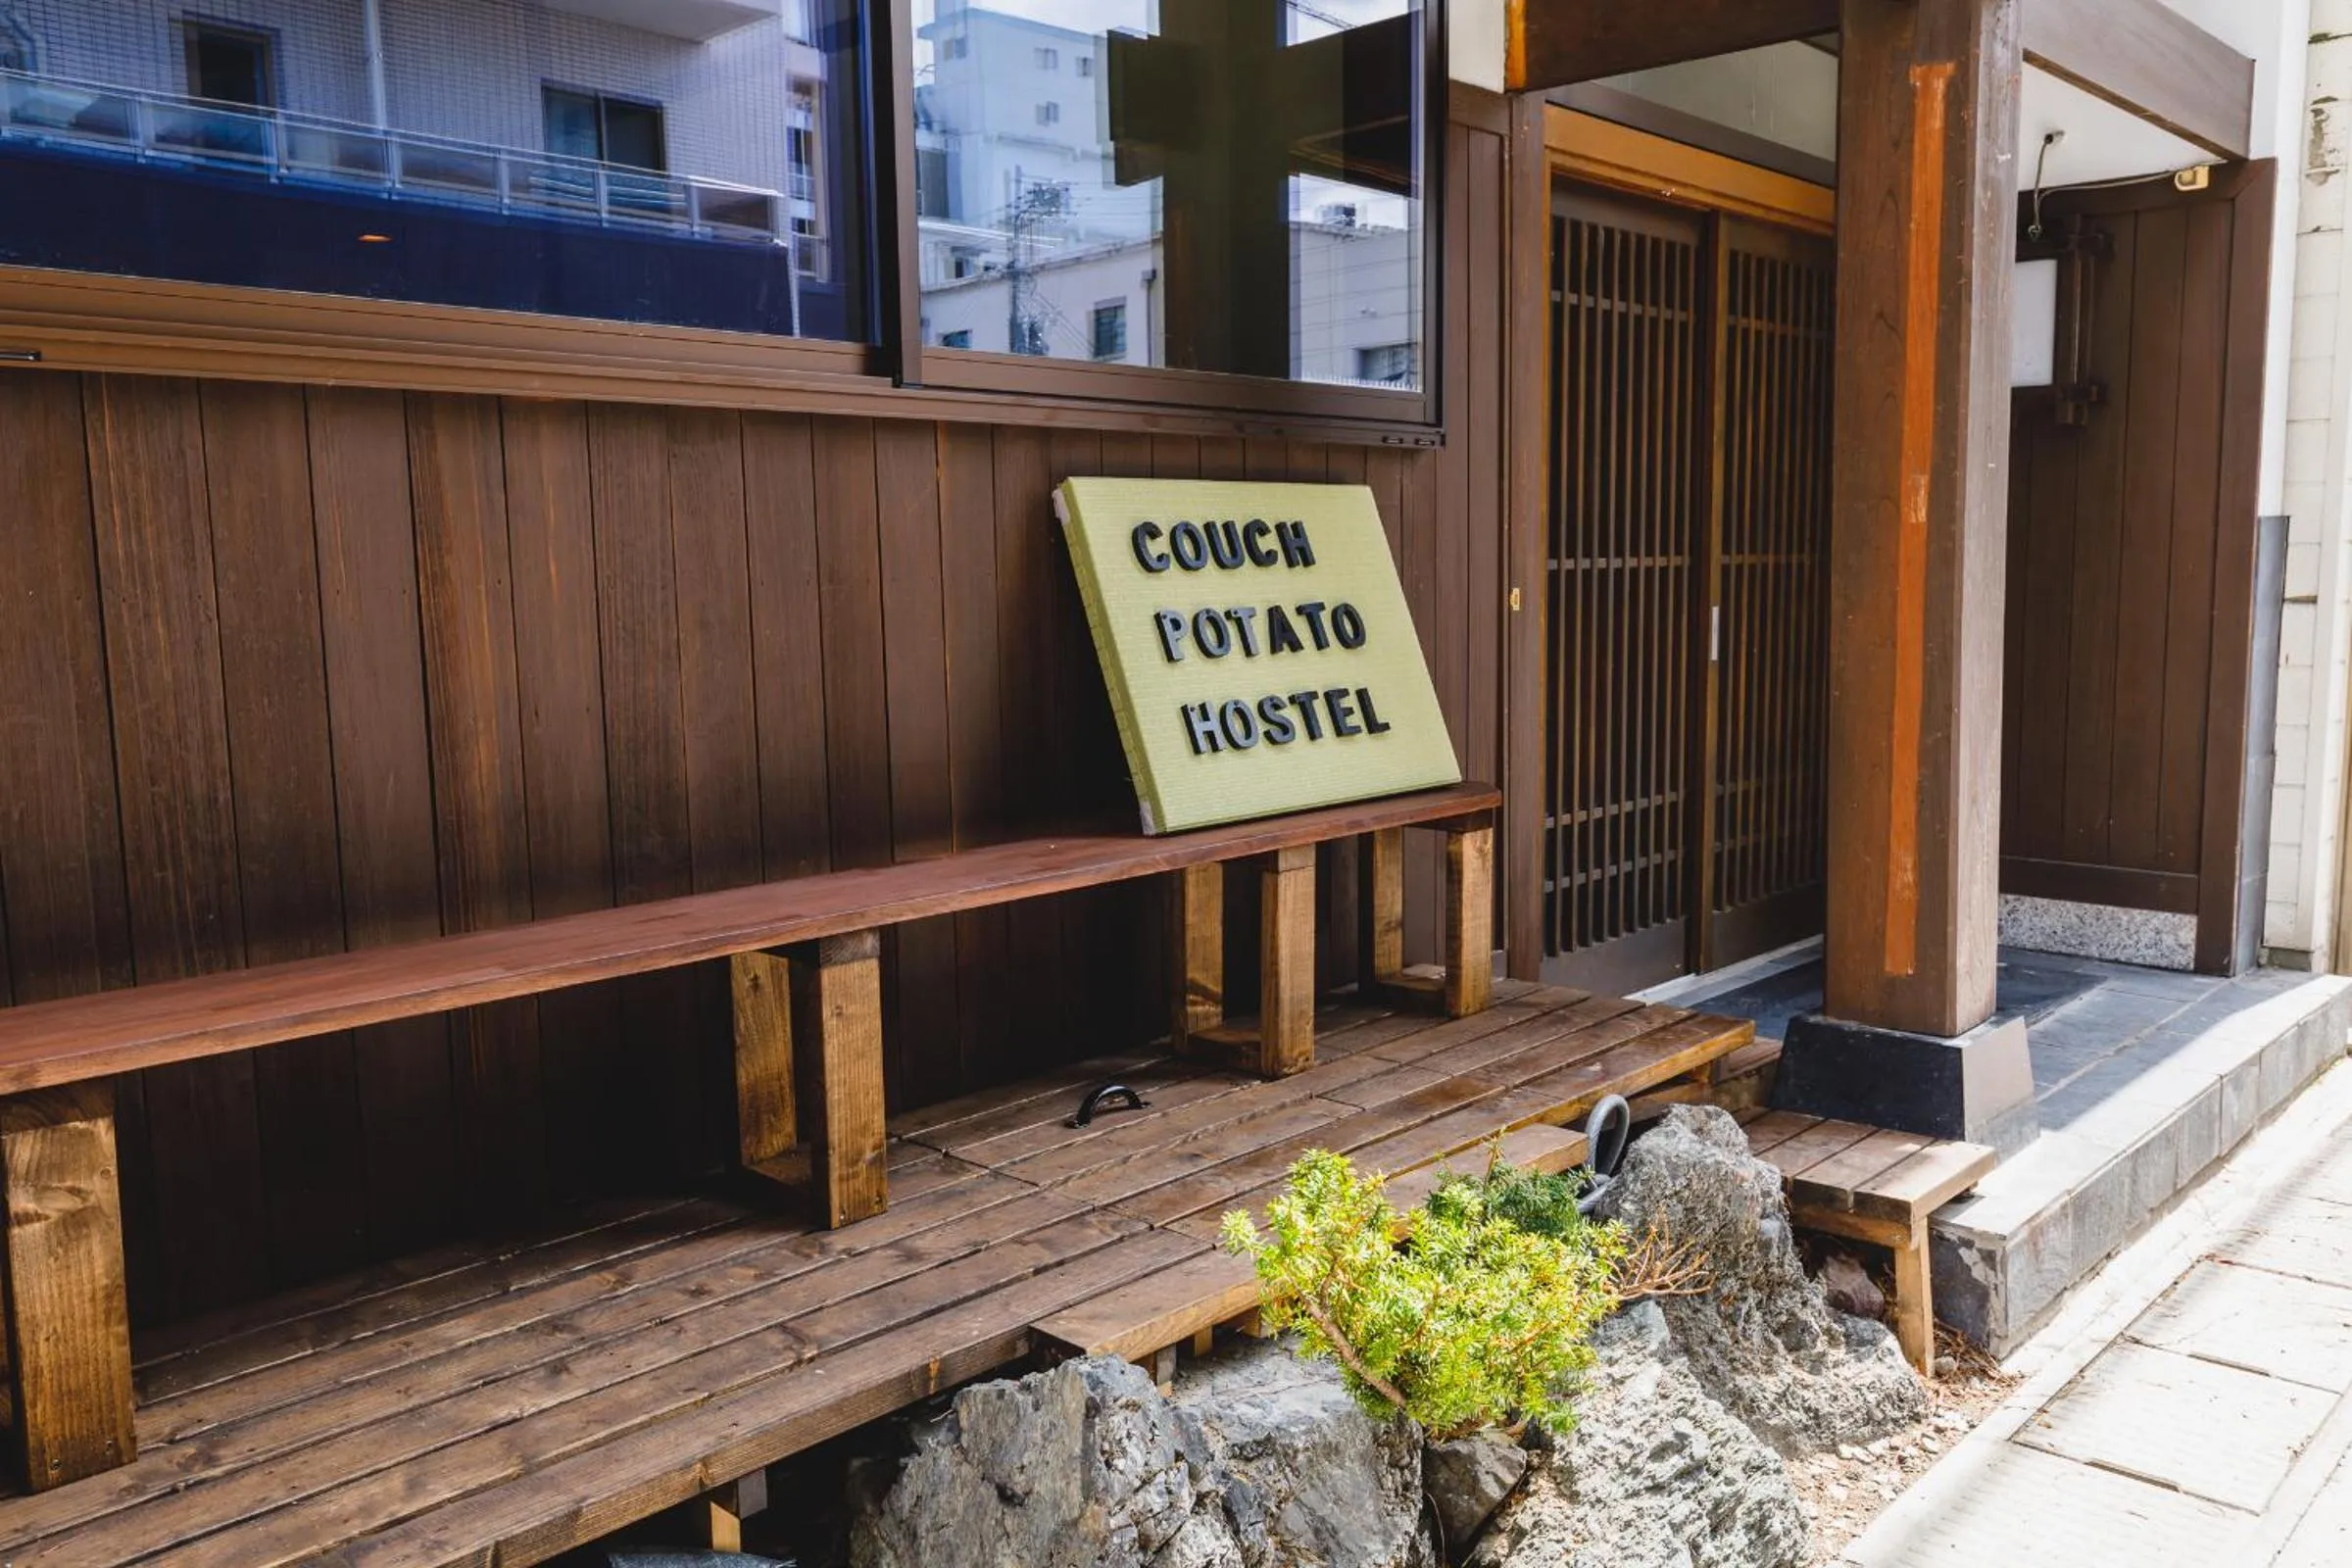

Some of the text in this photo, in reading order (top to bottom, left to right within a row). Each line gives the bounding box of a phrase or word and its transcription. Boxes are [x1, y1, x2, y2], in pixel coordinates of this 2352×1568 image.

[1131, 518, 1316, 573] COUCH
[1153, 602, 1366, 662] POTATO
[1180, 687, 1391, 755] HOSTEL
